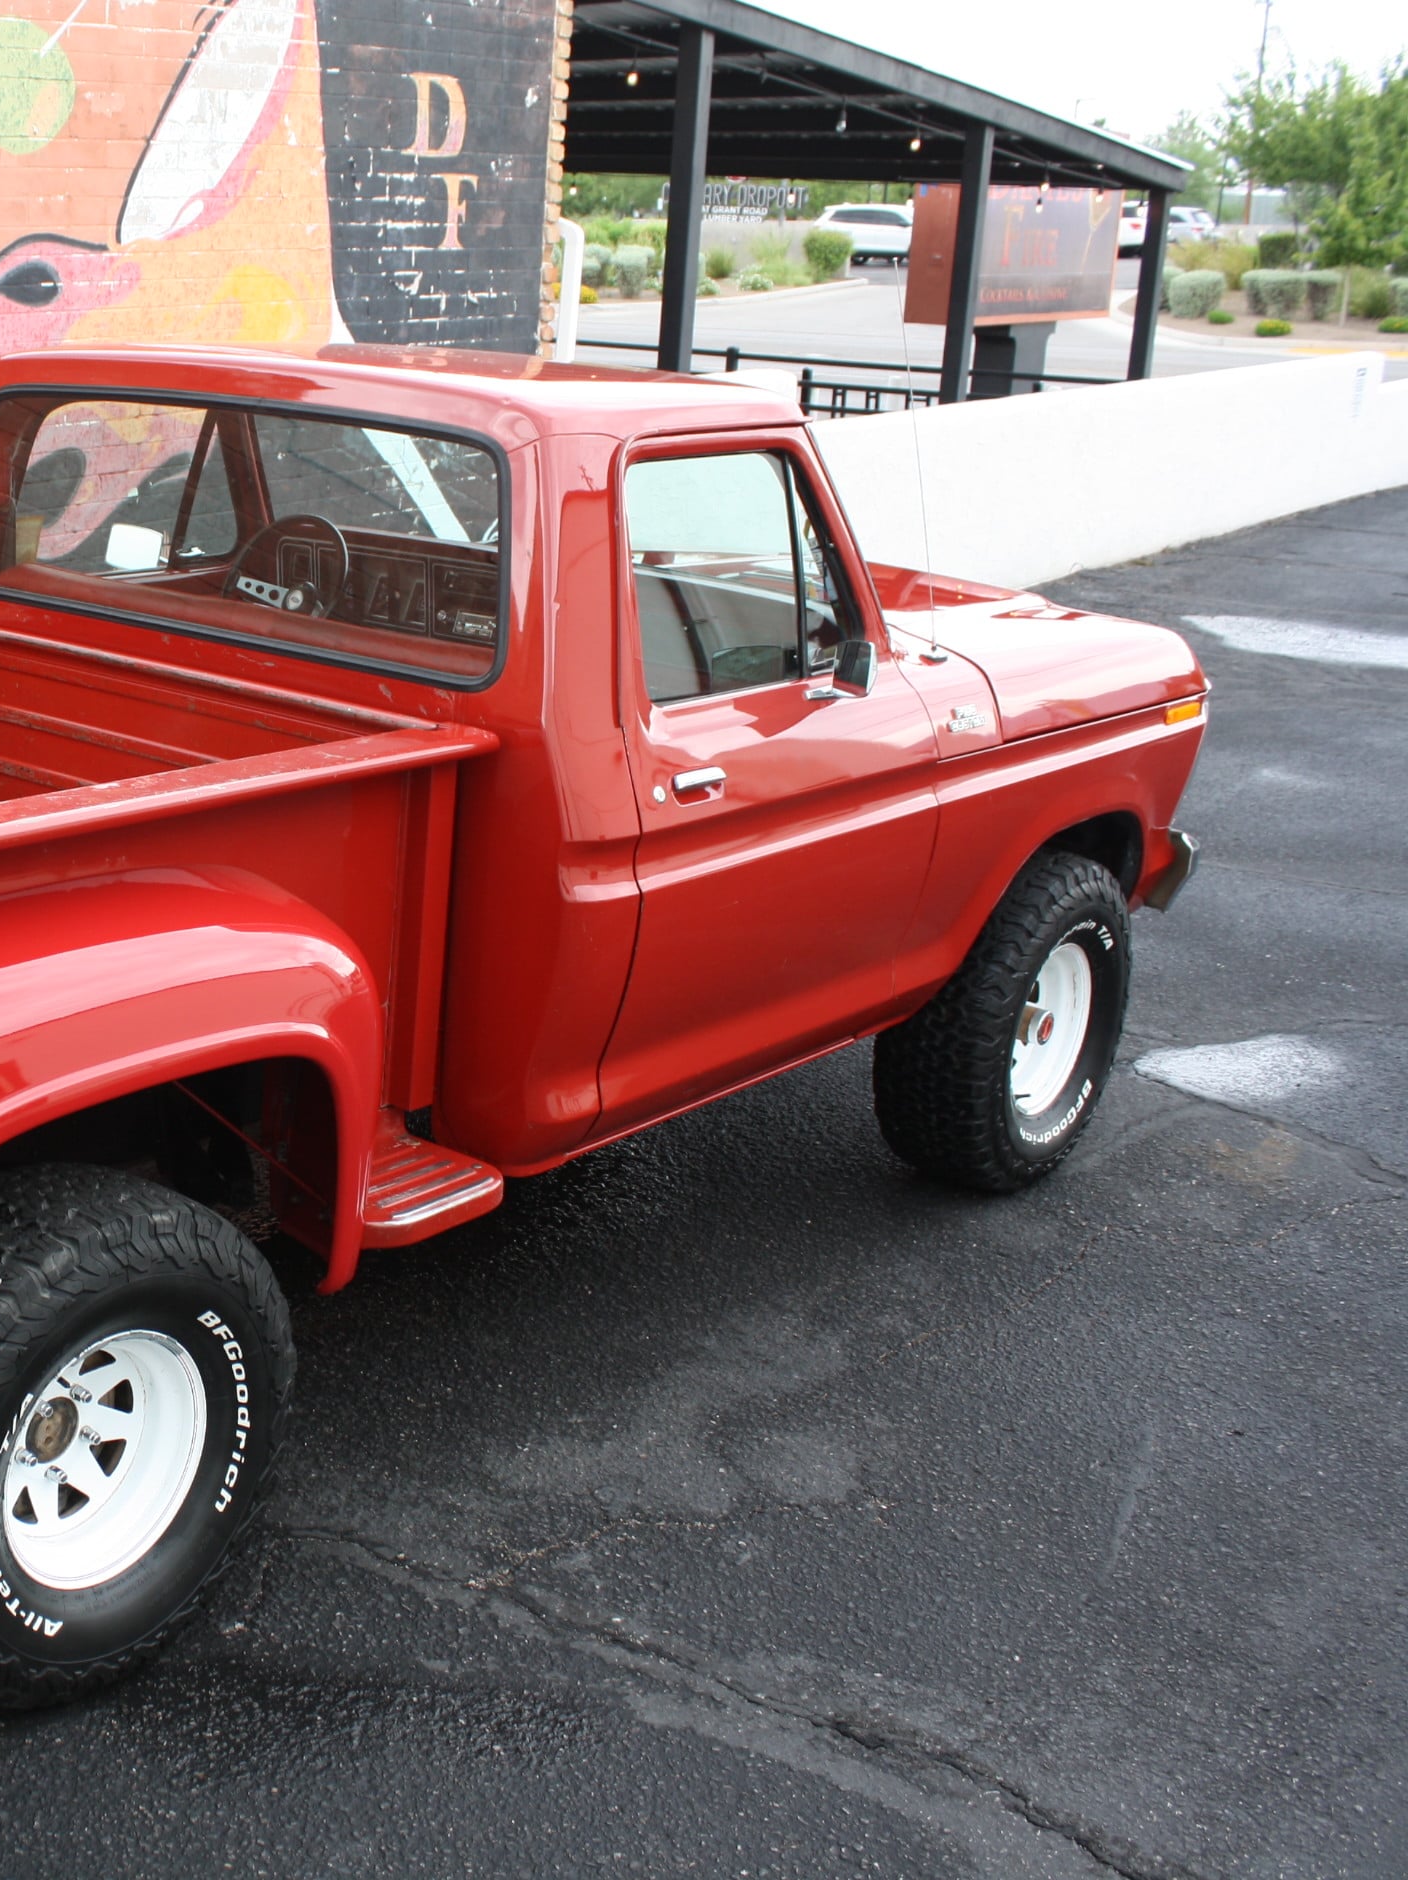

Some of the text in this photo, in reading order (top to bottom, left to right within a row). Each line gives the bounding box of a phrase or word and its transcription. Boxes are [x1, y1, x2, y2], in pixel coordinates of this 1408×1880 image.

[402, 72, 467, 157] D
[435, 174, 479, 250] F
[703, 215, 739, 223] LUMBER
[712, 206, 741, 214] GRANT
[743, 207, 768, 215] ROAD
[737, 184, 806, 209] DROPOUT
[1097, 925, 1114, 951] T/A
[1019, 1079, 1092, 1145] BFGoodrich
[197, 1310, 251, 1512] BFGoodrich
